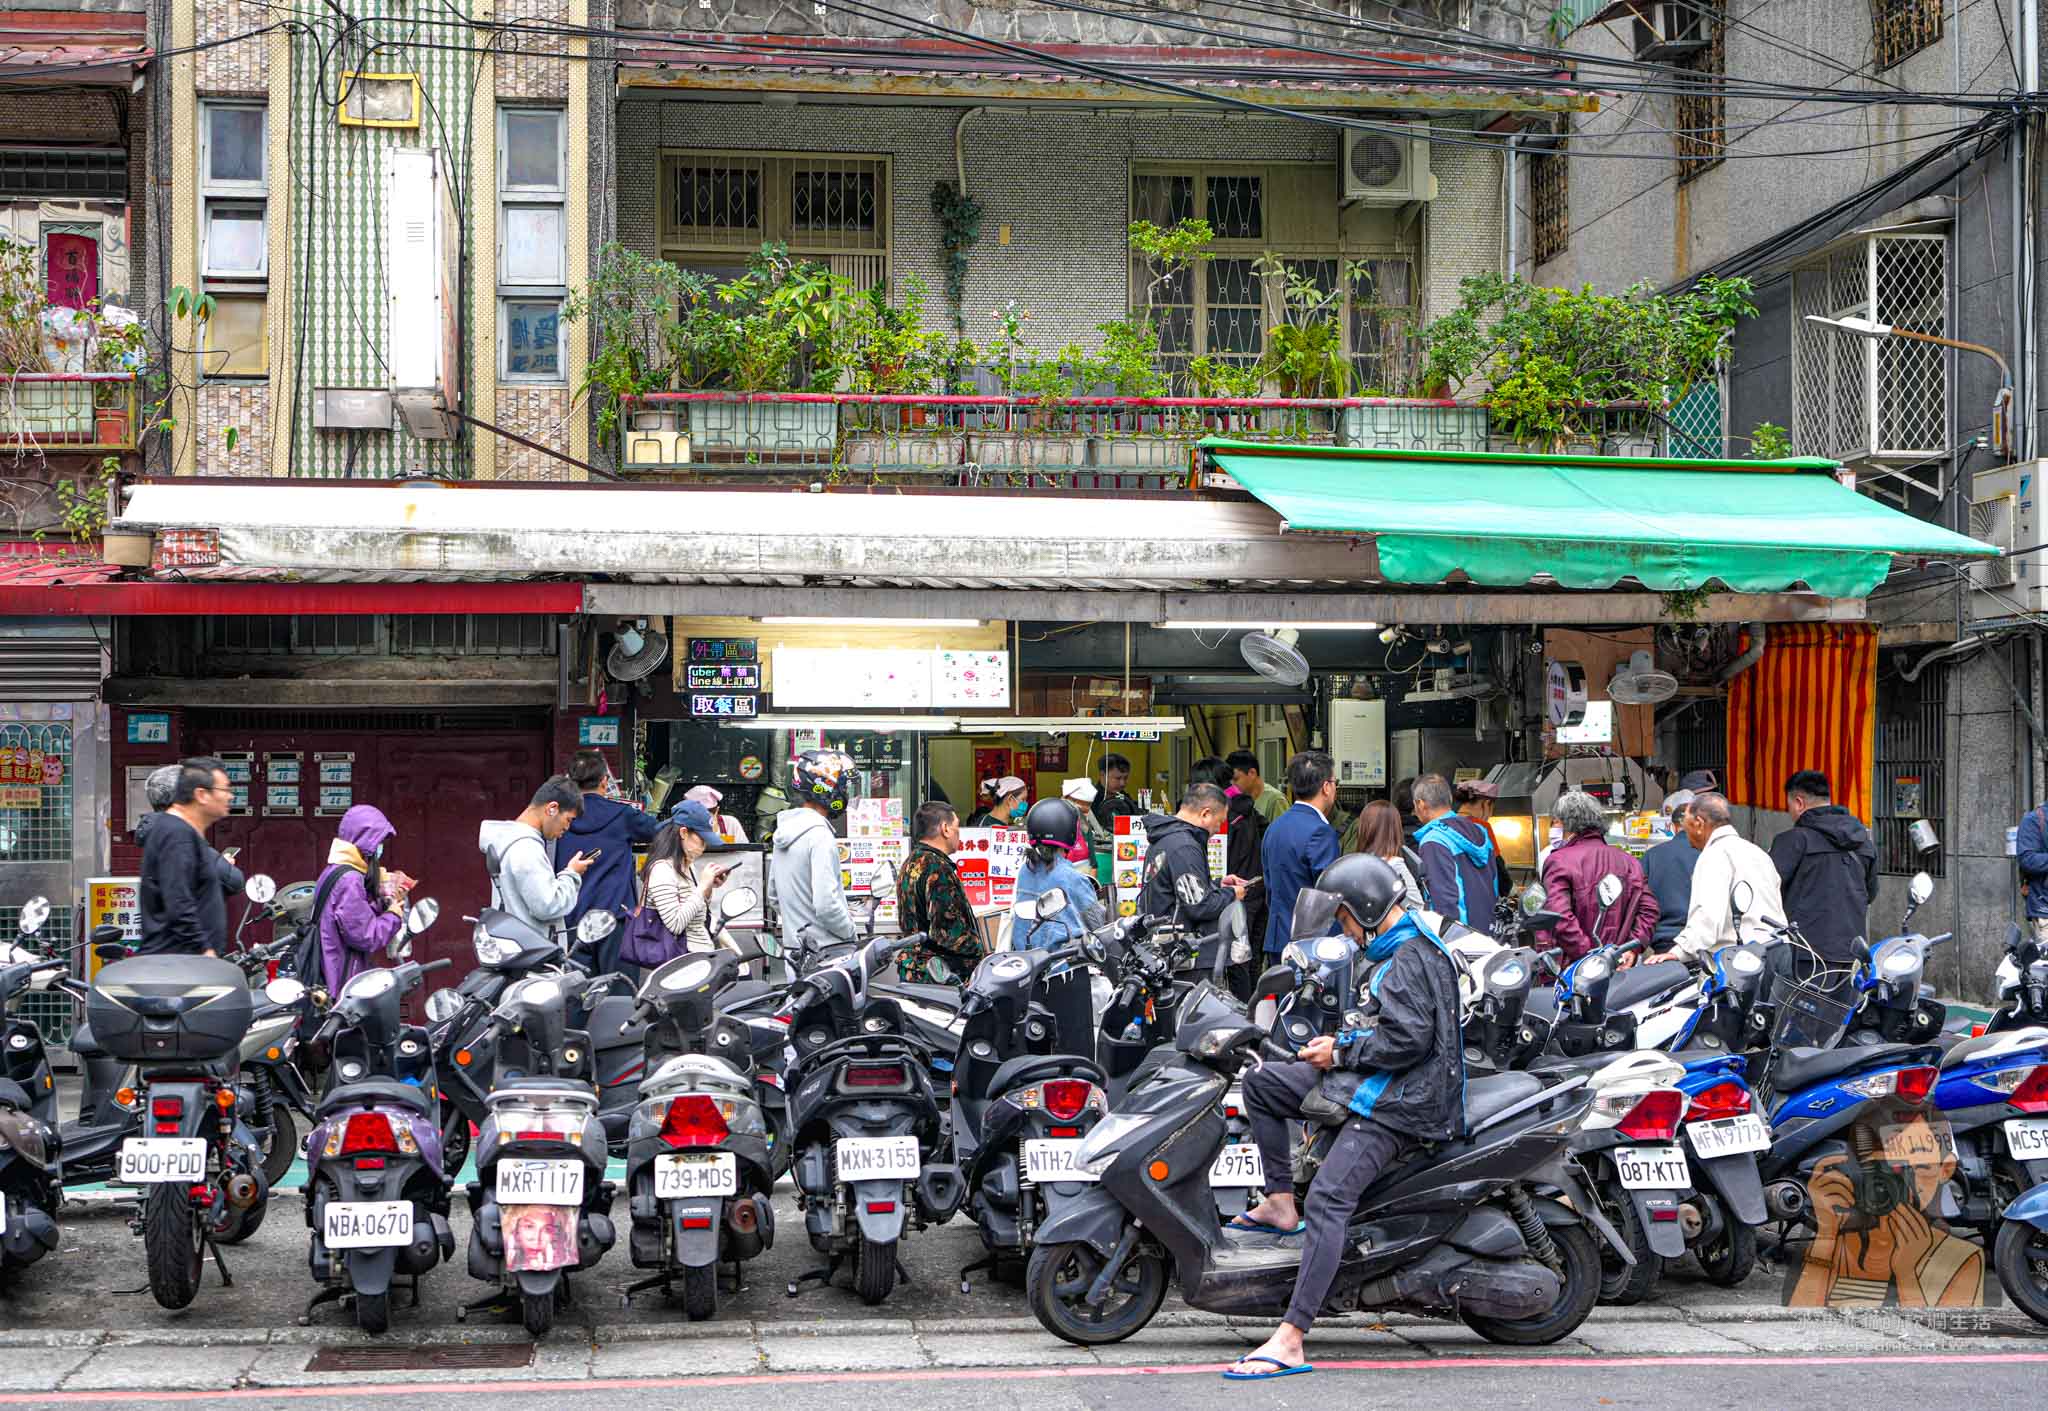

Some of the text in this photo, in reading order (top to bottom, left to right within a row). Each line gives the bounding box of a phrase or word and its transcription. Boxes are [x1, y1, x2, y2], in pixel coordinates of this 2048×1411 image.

[692, 668, 716, 677] uber
[696, 697, 751, 713] 取餐區
[145, 728, 160, 739] 46
[597, 731, 610, 742] 44
[1694, 1125, 1761, 1150] MFN-9779
[124, 1153, 202, 1175] 900-PDD
[841, 1147, 916, 1171] MXN-3155
[500, 1171, 579, 1193] MXR-1117
[658, 1168, 733, 1190] 739-MDS
[1620, 1161, 1686, 1183] 087-KTT
[328, 1213, 410, 1237] NBA-0670
